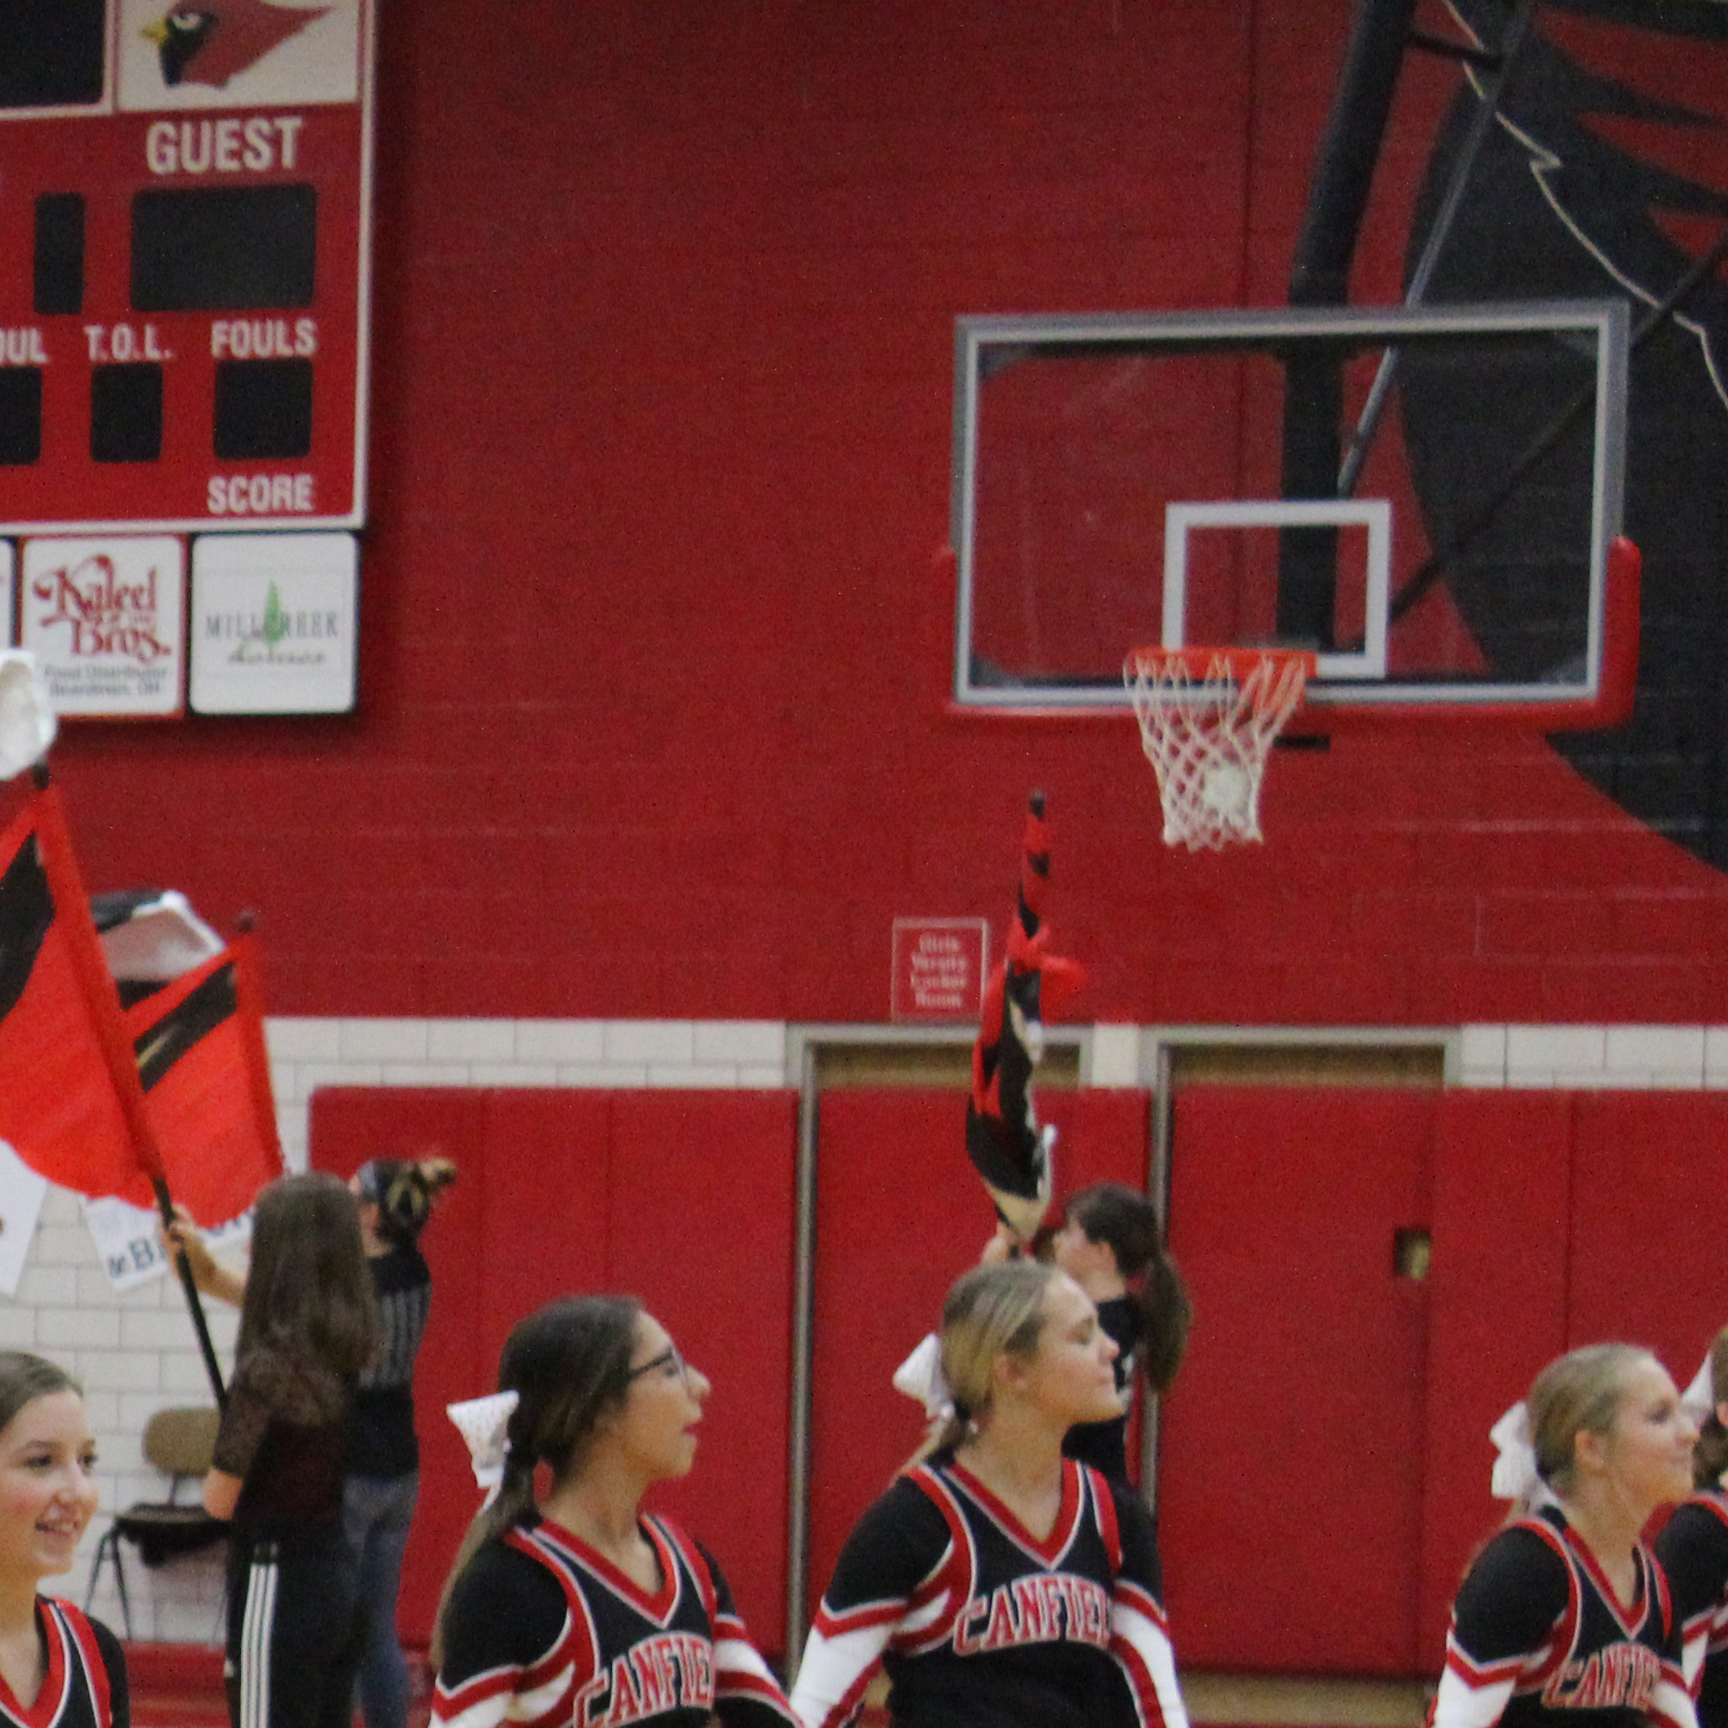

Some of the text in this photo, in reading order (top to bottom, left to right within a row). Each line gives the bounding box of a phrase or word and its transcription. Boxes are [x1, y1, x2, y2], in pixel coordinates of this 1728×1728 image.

[145, 118, 304, 174] GUEST
[85, 326, 173, 362] T.O.L.
[211, 320, 318, 358] FOULS
[207, 475, 314, 514] SCORE
